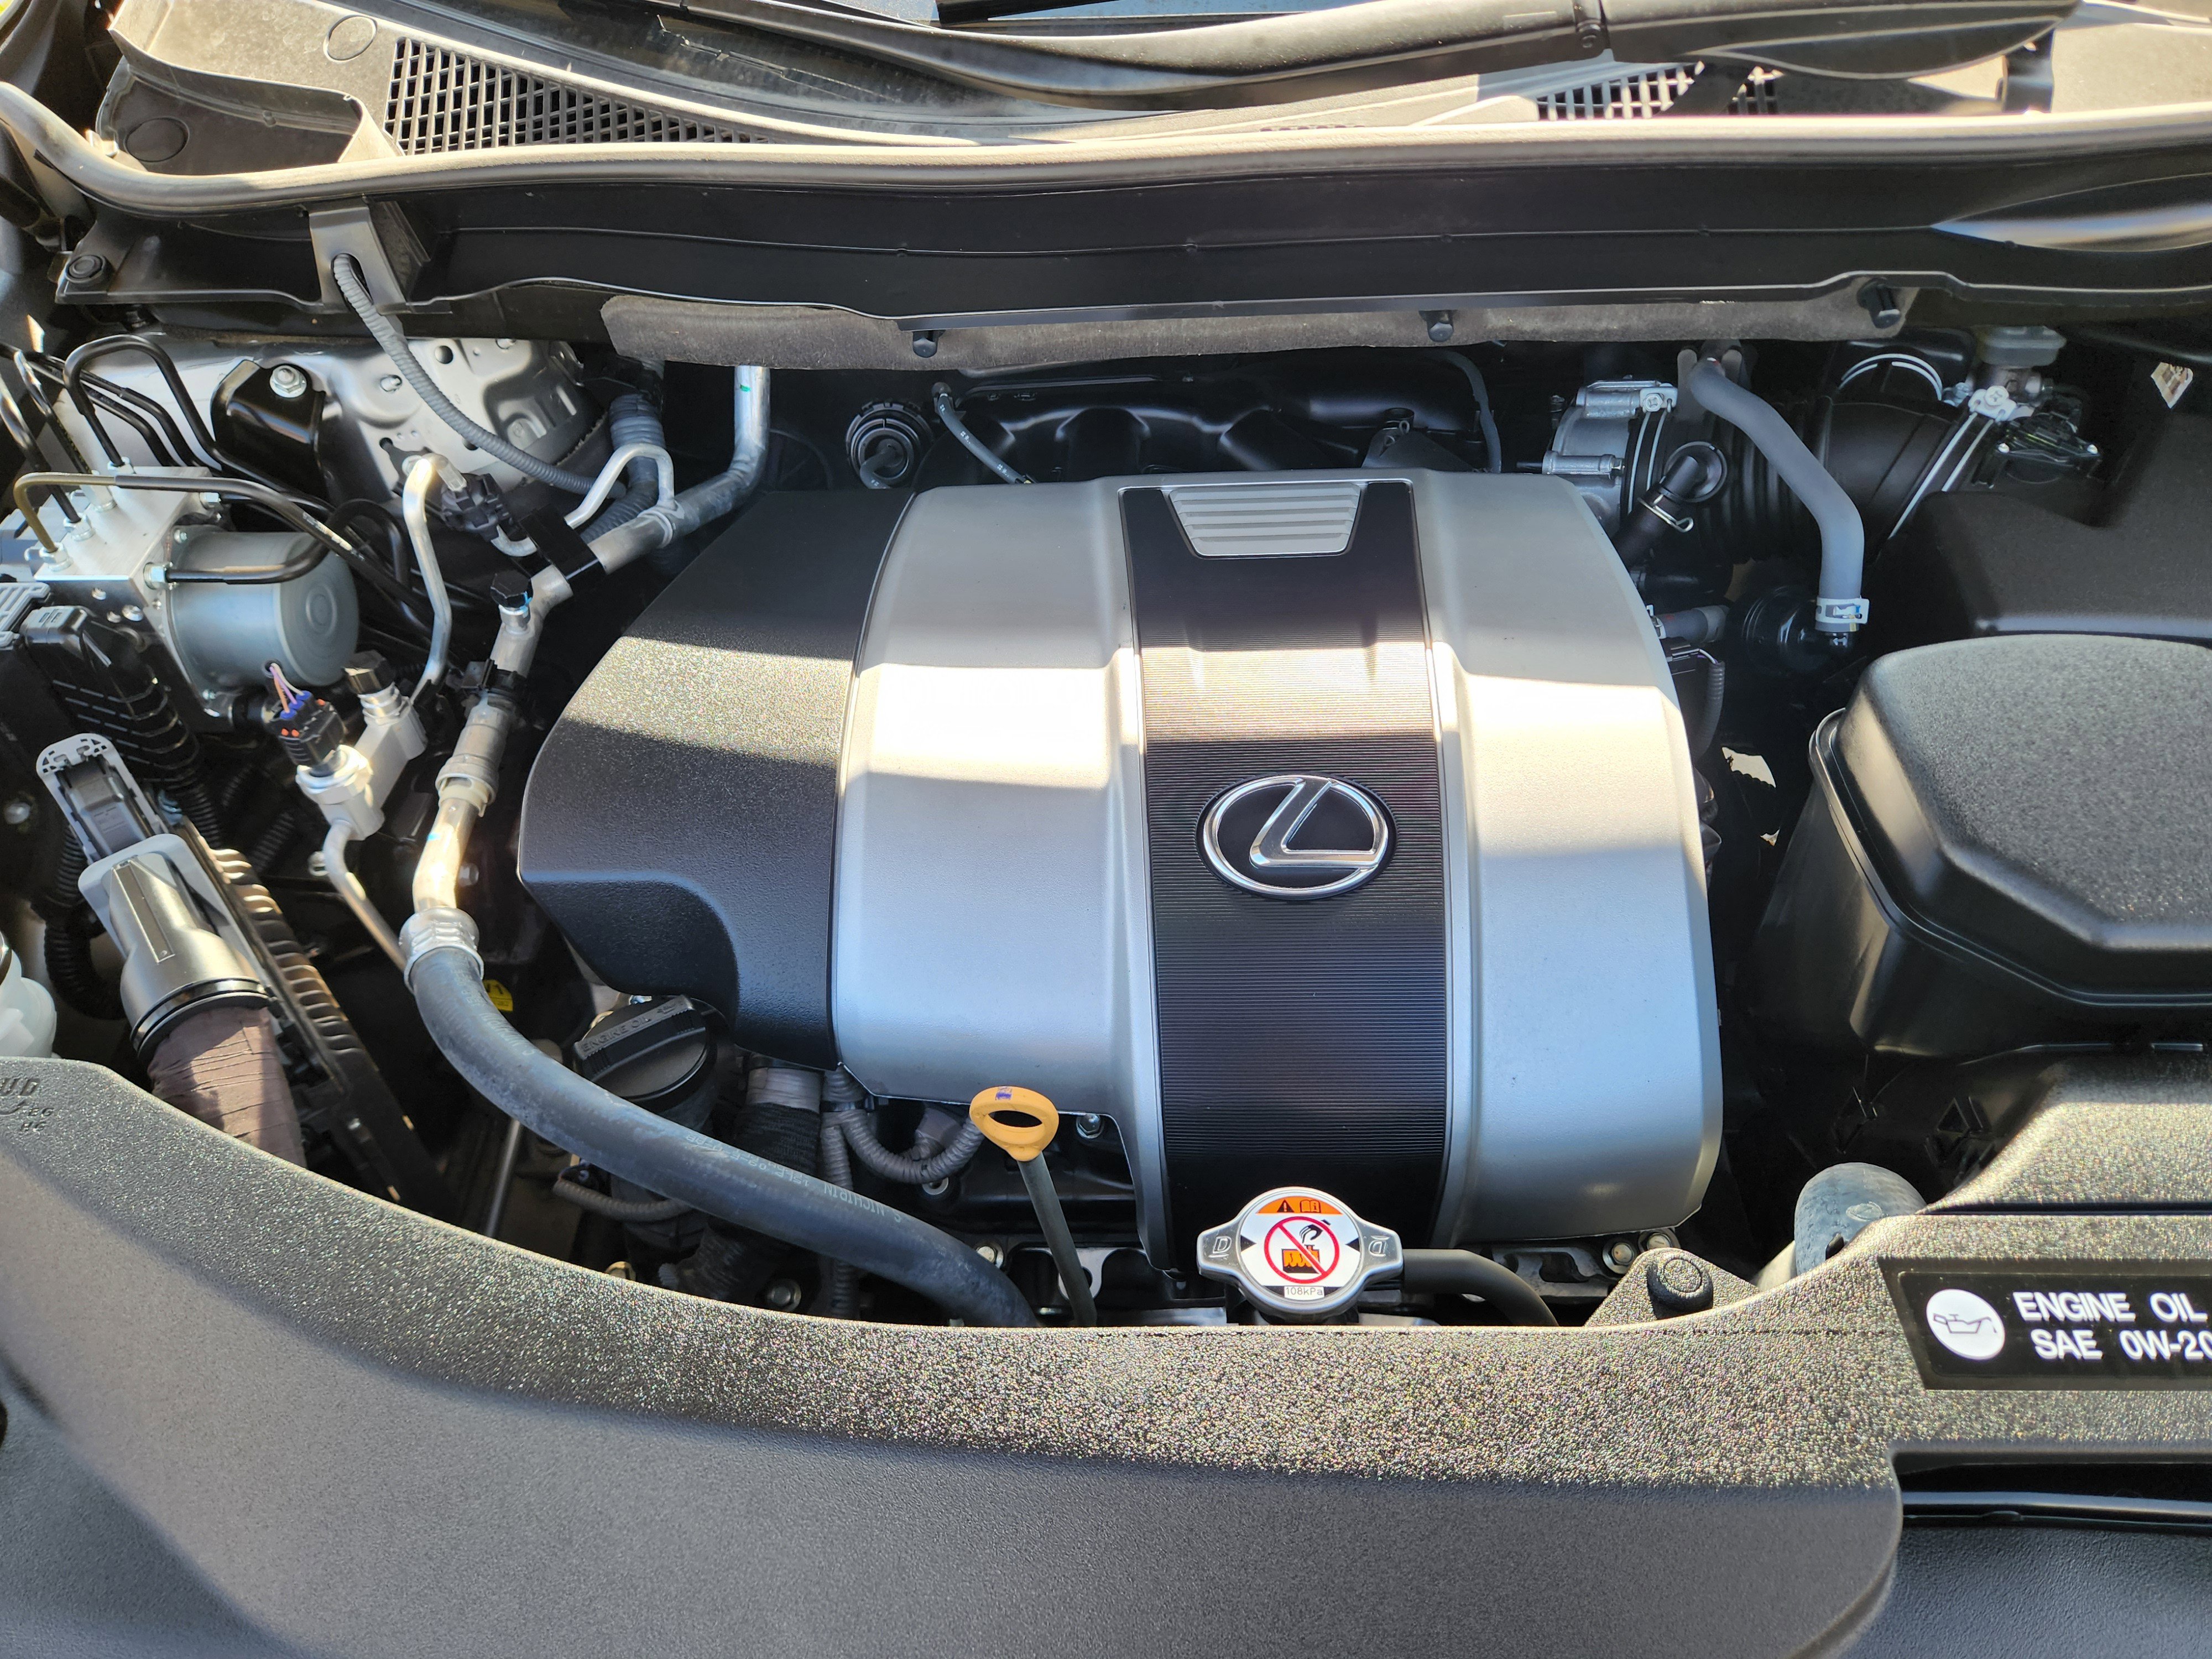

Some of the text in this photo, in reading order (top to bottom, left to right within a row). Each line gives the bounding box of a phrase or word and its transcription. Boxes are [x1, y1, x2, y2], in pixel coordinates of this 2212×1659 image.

[583, 1016, 651, 1051] ENGINE OIL
[1285, 1287, 1323, 1295] 108kPa
[2012, 1291, 2209, 1322] ENGINE OIL
[2030, 1329, 2103, 1360] SAE
